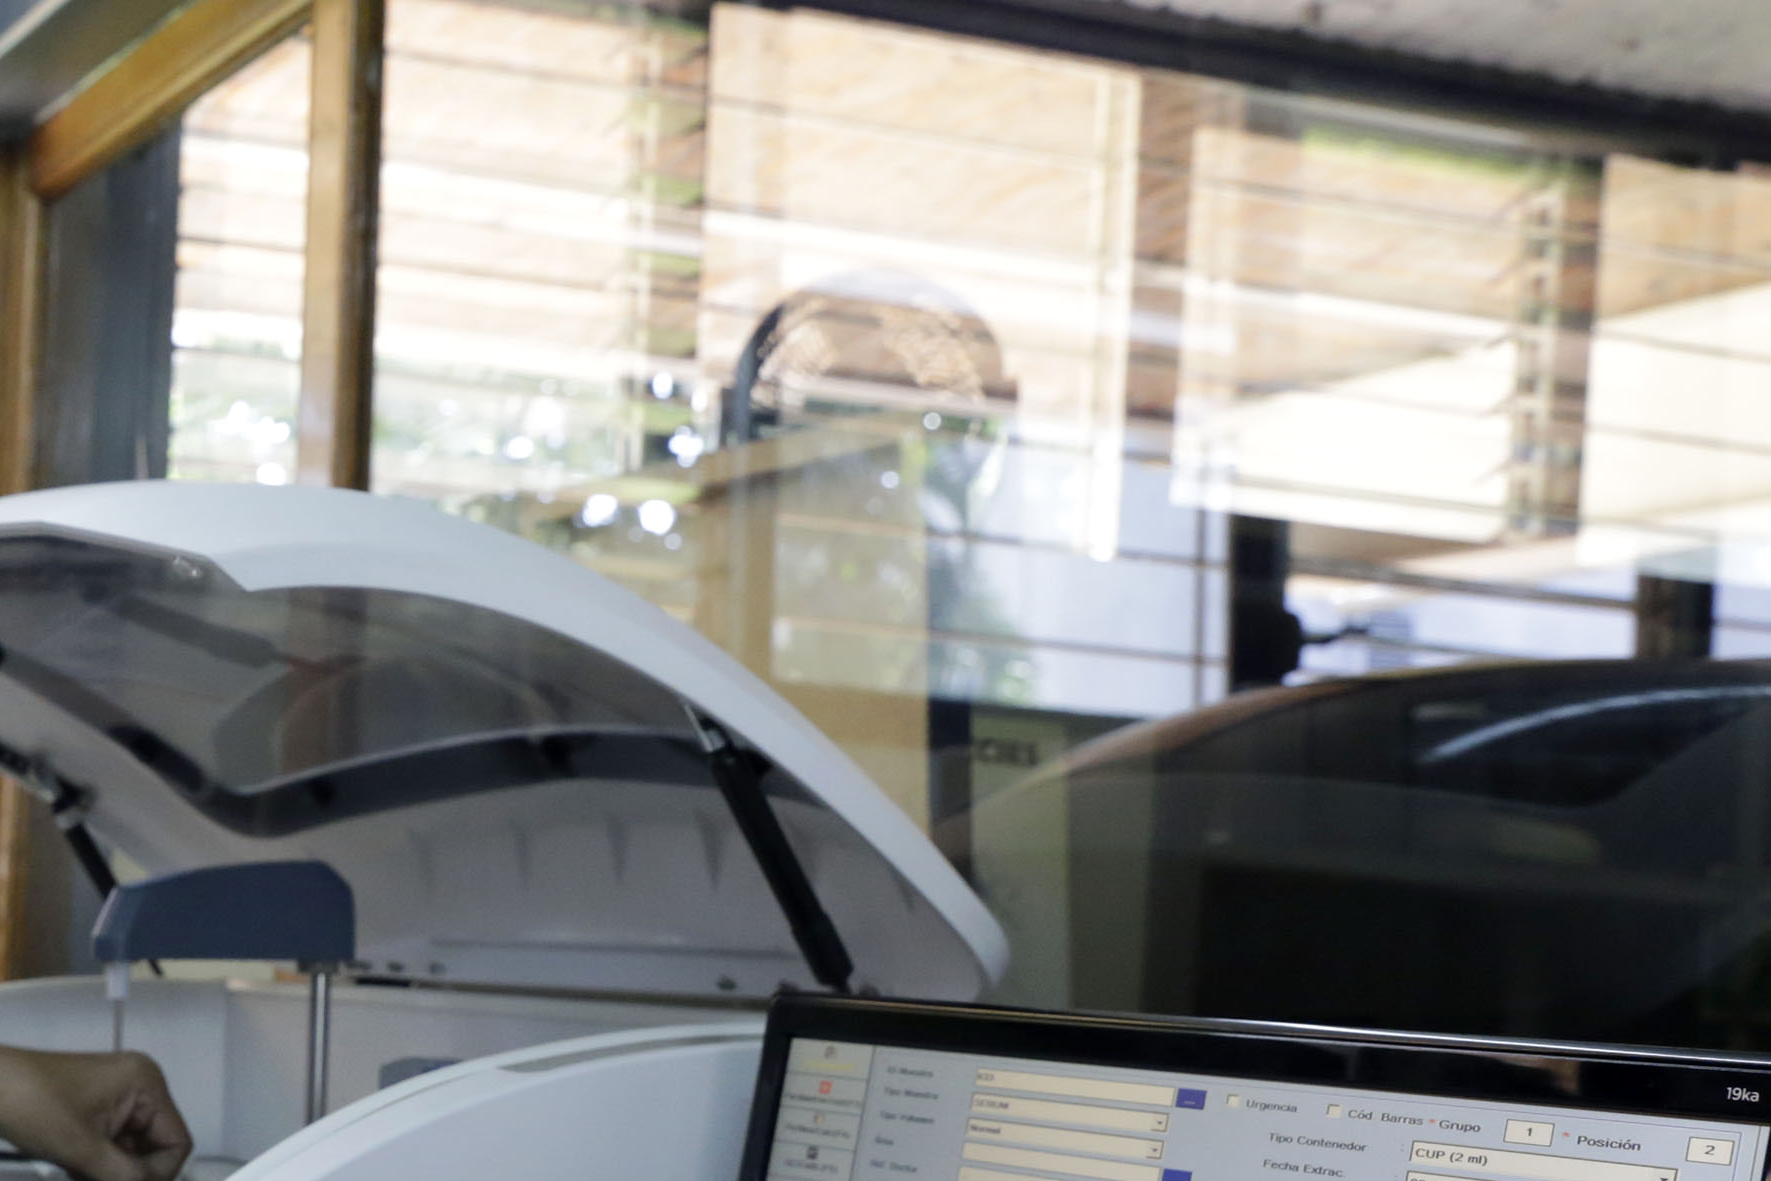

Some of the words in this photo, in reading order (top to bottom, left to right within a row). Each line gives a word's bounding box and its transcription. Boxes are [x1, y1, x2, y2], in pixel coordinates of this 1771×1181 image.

[1726, 1086, 1760, 1102] 19ka
[1245, 1099, 1298, 1113] Urgencia
[1380, 1112, 1424, 1126] Barras
[1438, 1119, 1482, 1133] Grupo
[1527, 1127, 1533, 1137] 1
[1269, 1132, 1294, 1144] Tipo
[1296, 1135, 1367, 1152] Contenedor
[1576, 1135, 1641, 1151] Posición
[1415, 1148, 1446, 1159] CUP
[1449, 1151, 1464, 1163] (2
[1467, 1155, 1488, 1167] ml)
[1704, 1145, 1716, 1156] 2
[1262, 1159, 1300, 1172] Fecha
